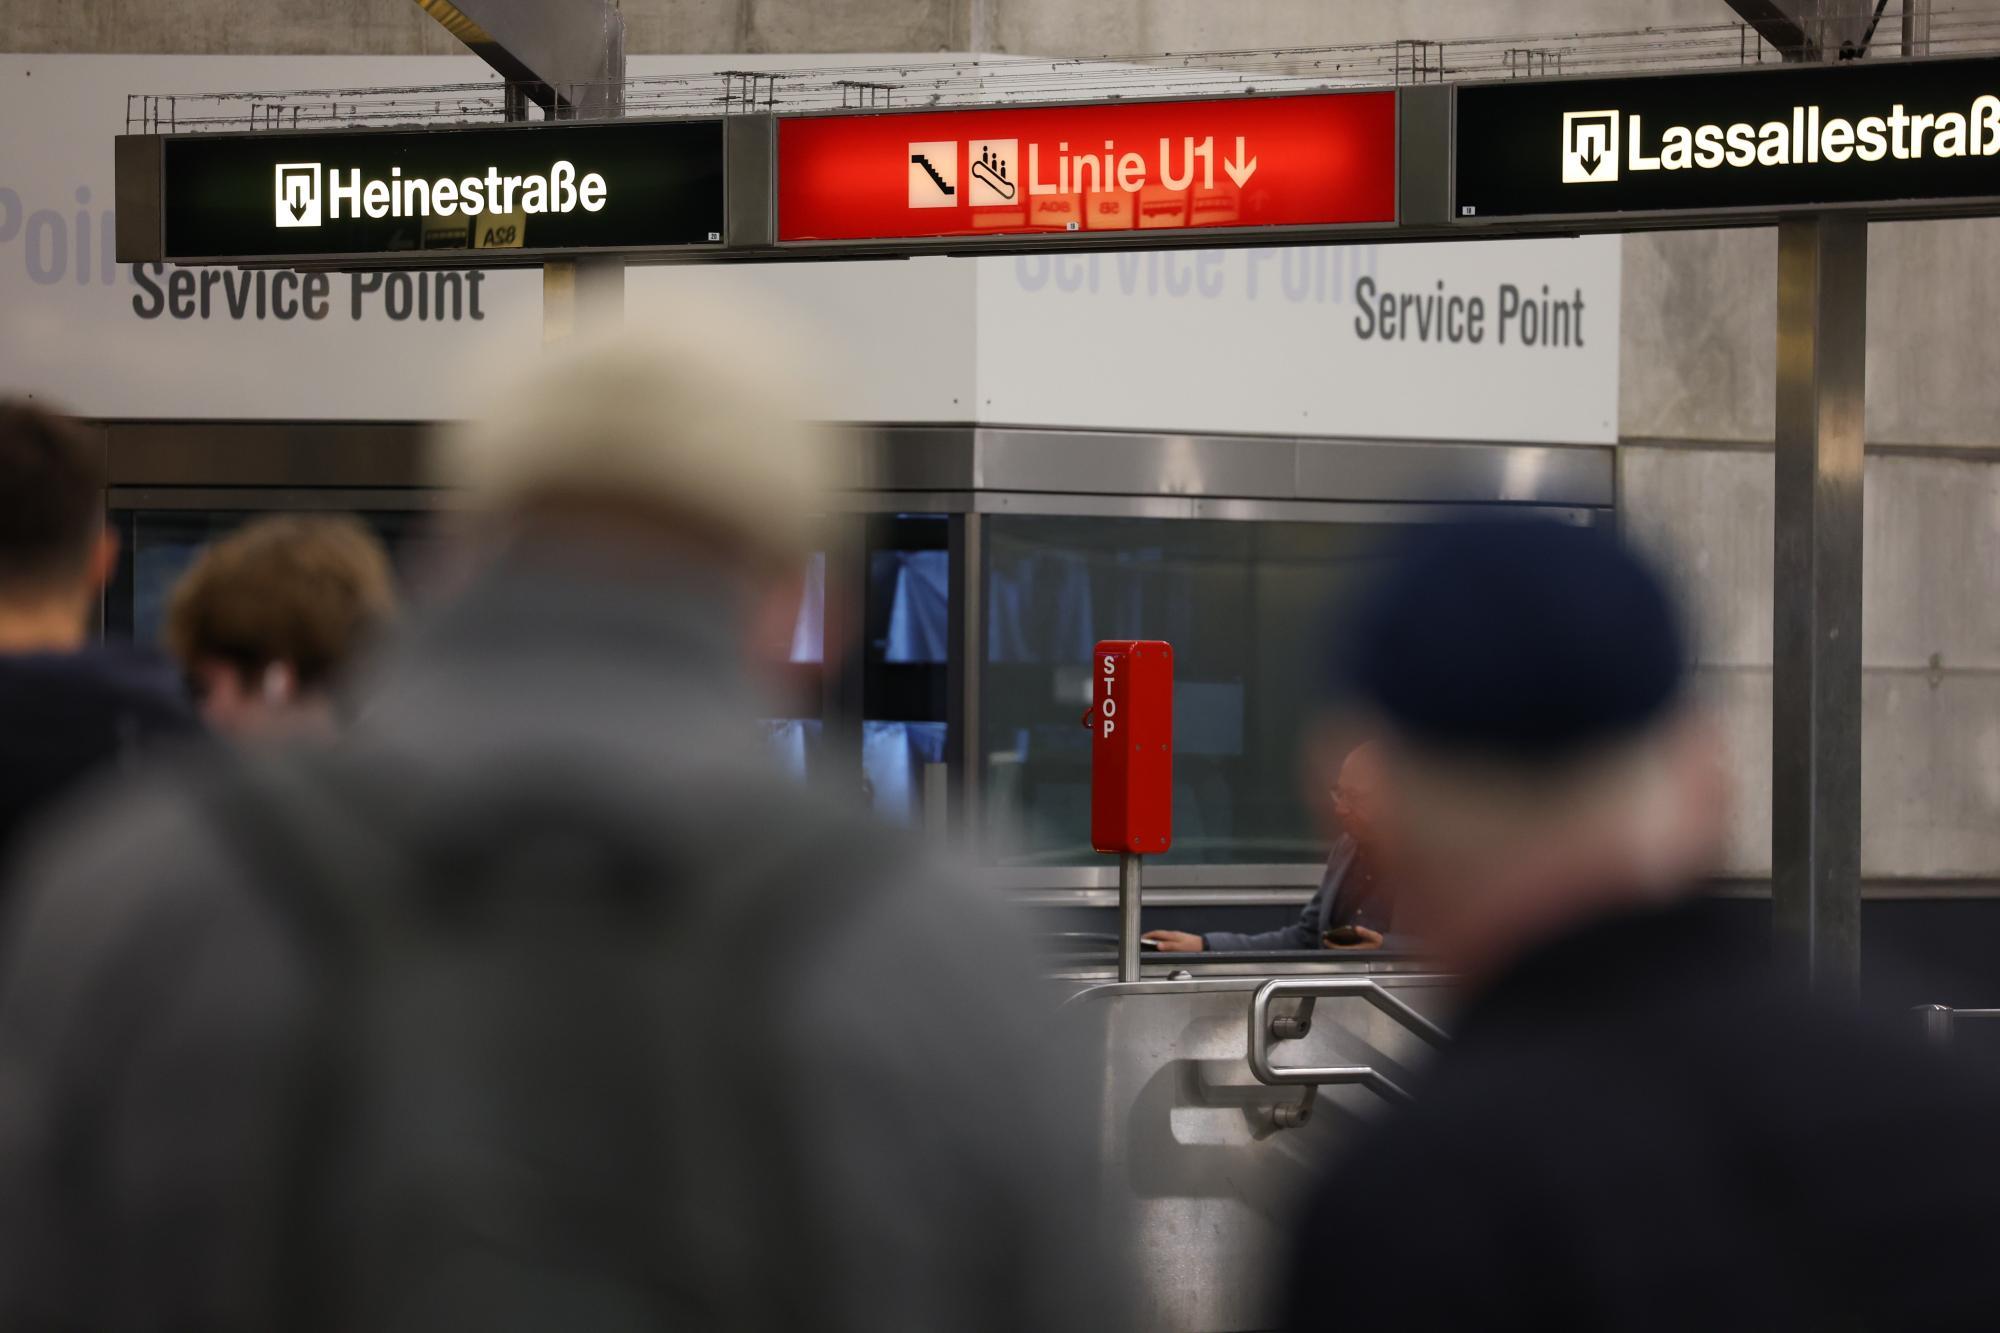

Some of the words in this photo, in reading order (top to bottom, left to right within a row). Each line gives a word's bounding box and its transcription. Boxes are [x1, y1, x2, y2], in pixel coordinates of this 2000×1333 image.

[1628, 94, 2000, 171] Lassallestraß
[329, 160, 607, 218] Heinestraße
[1028, 139, 1147, 196] Linie
[1159, 136, 1214, 192] U1
[132, 262, 330, 321] Service
[350, 271, 485, 322] Point
[1354, 275, 1485, 344] Service
[1498, 283, 1585, 348] Point
[1103, 656, 1116, 738] STOP
